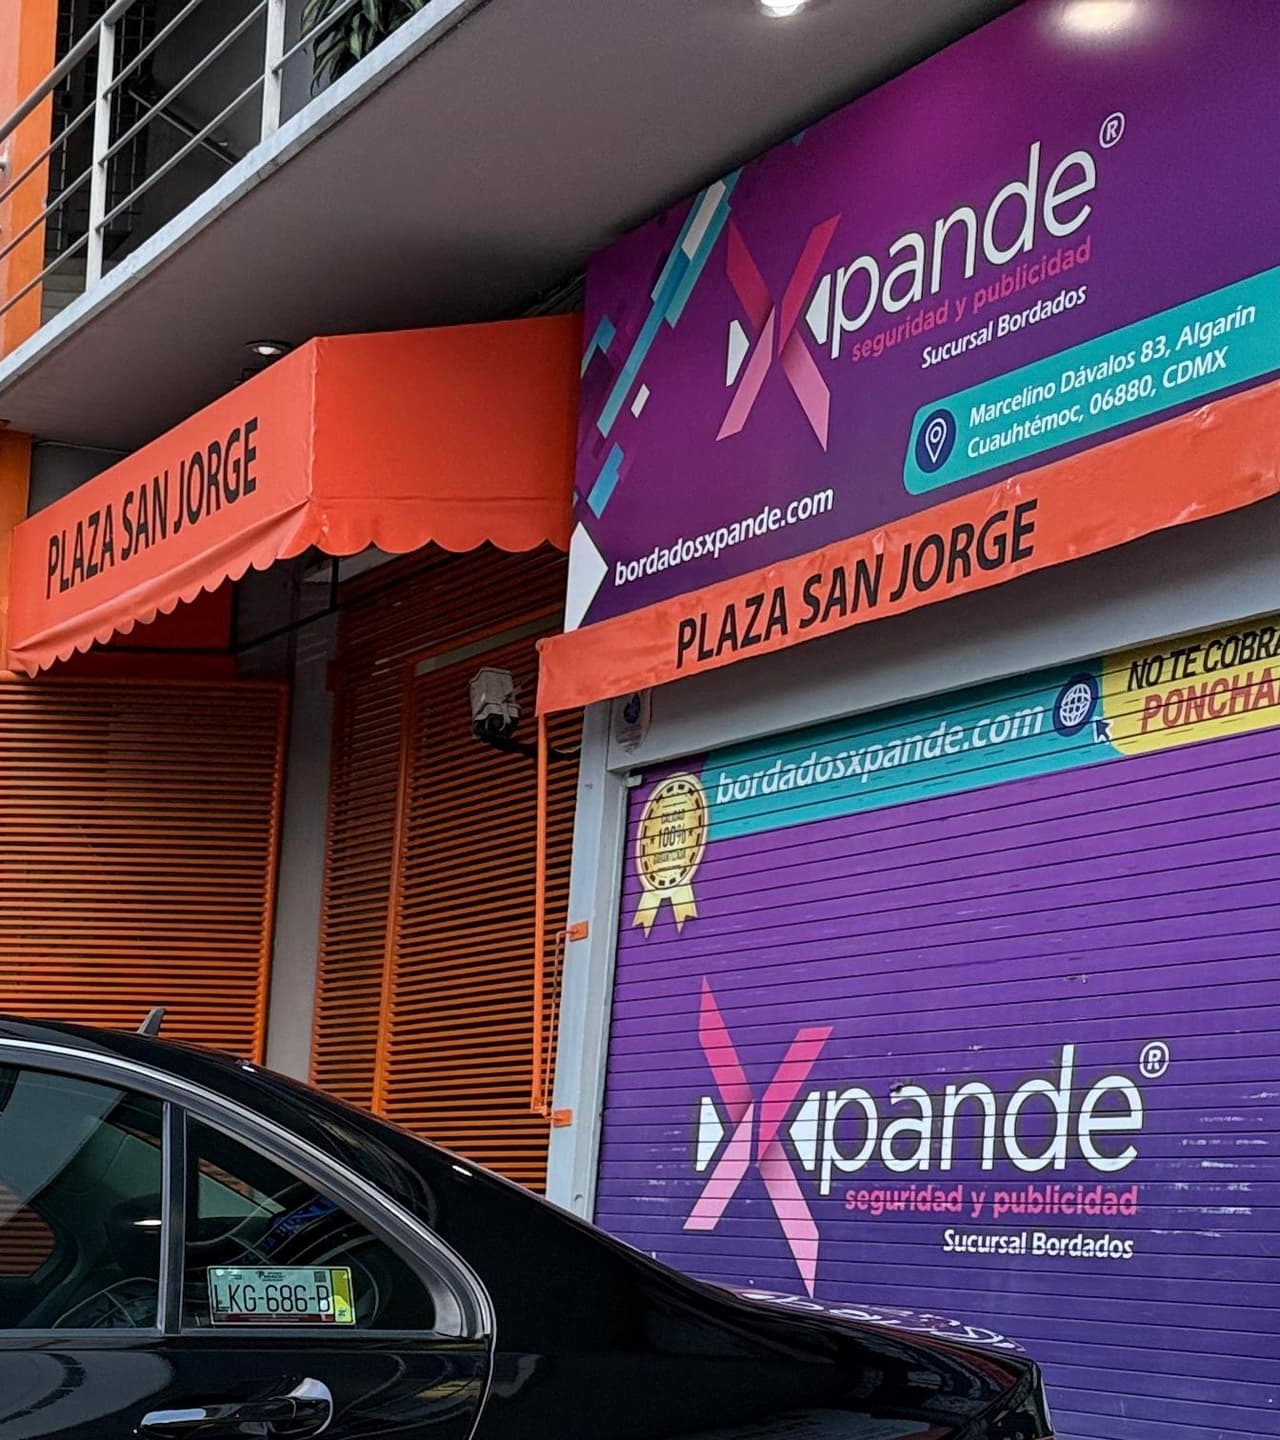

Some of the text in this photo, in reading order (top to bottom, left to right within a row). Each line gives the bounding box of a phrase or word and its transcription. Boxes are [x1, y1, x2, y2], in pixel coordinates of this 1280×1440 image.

[852, 235, 1092, 362] seguridad y publicidad
[921, 285, 1087, 369] Sucursal Bordados
[967, 346, 1229, 458] Cuauhtémoc, 06880, CDMX
[968, 304, 1256, 428] Marcelino Dávalos 83, Algarín
[46, 416, 258, 600] PLAZA SAN JORGE
[614, 488, 835, 587] bordadosxpande.com
[676, 498, 1039, 669] PLAZA SAN JORGE
[1127, 655, 1165, 692] NO
[1171, 644, 1201, 681] TE
[1141, 667, 1280, 733] PONCHA
[716, 705, 1045, 804] bordadosxpande.com
[845, 1184, 1139, 1219] seguridad y publicidad
[943, 1229, 1134, 1260] Sucursal Bordados
[213, 1284, 331, 1313] LKG-686-B
